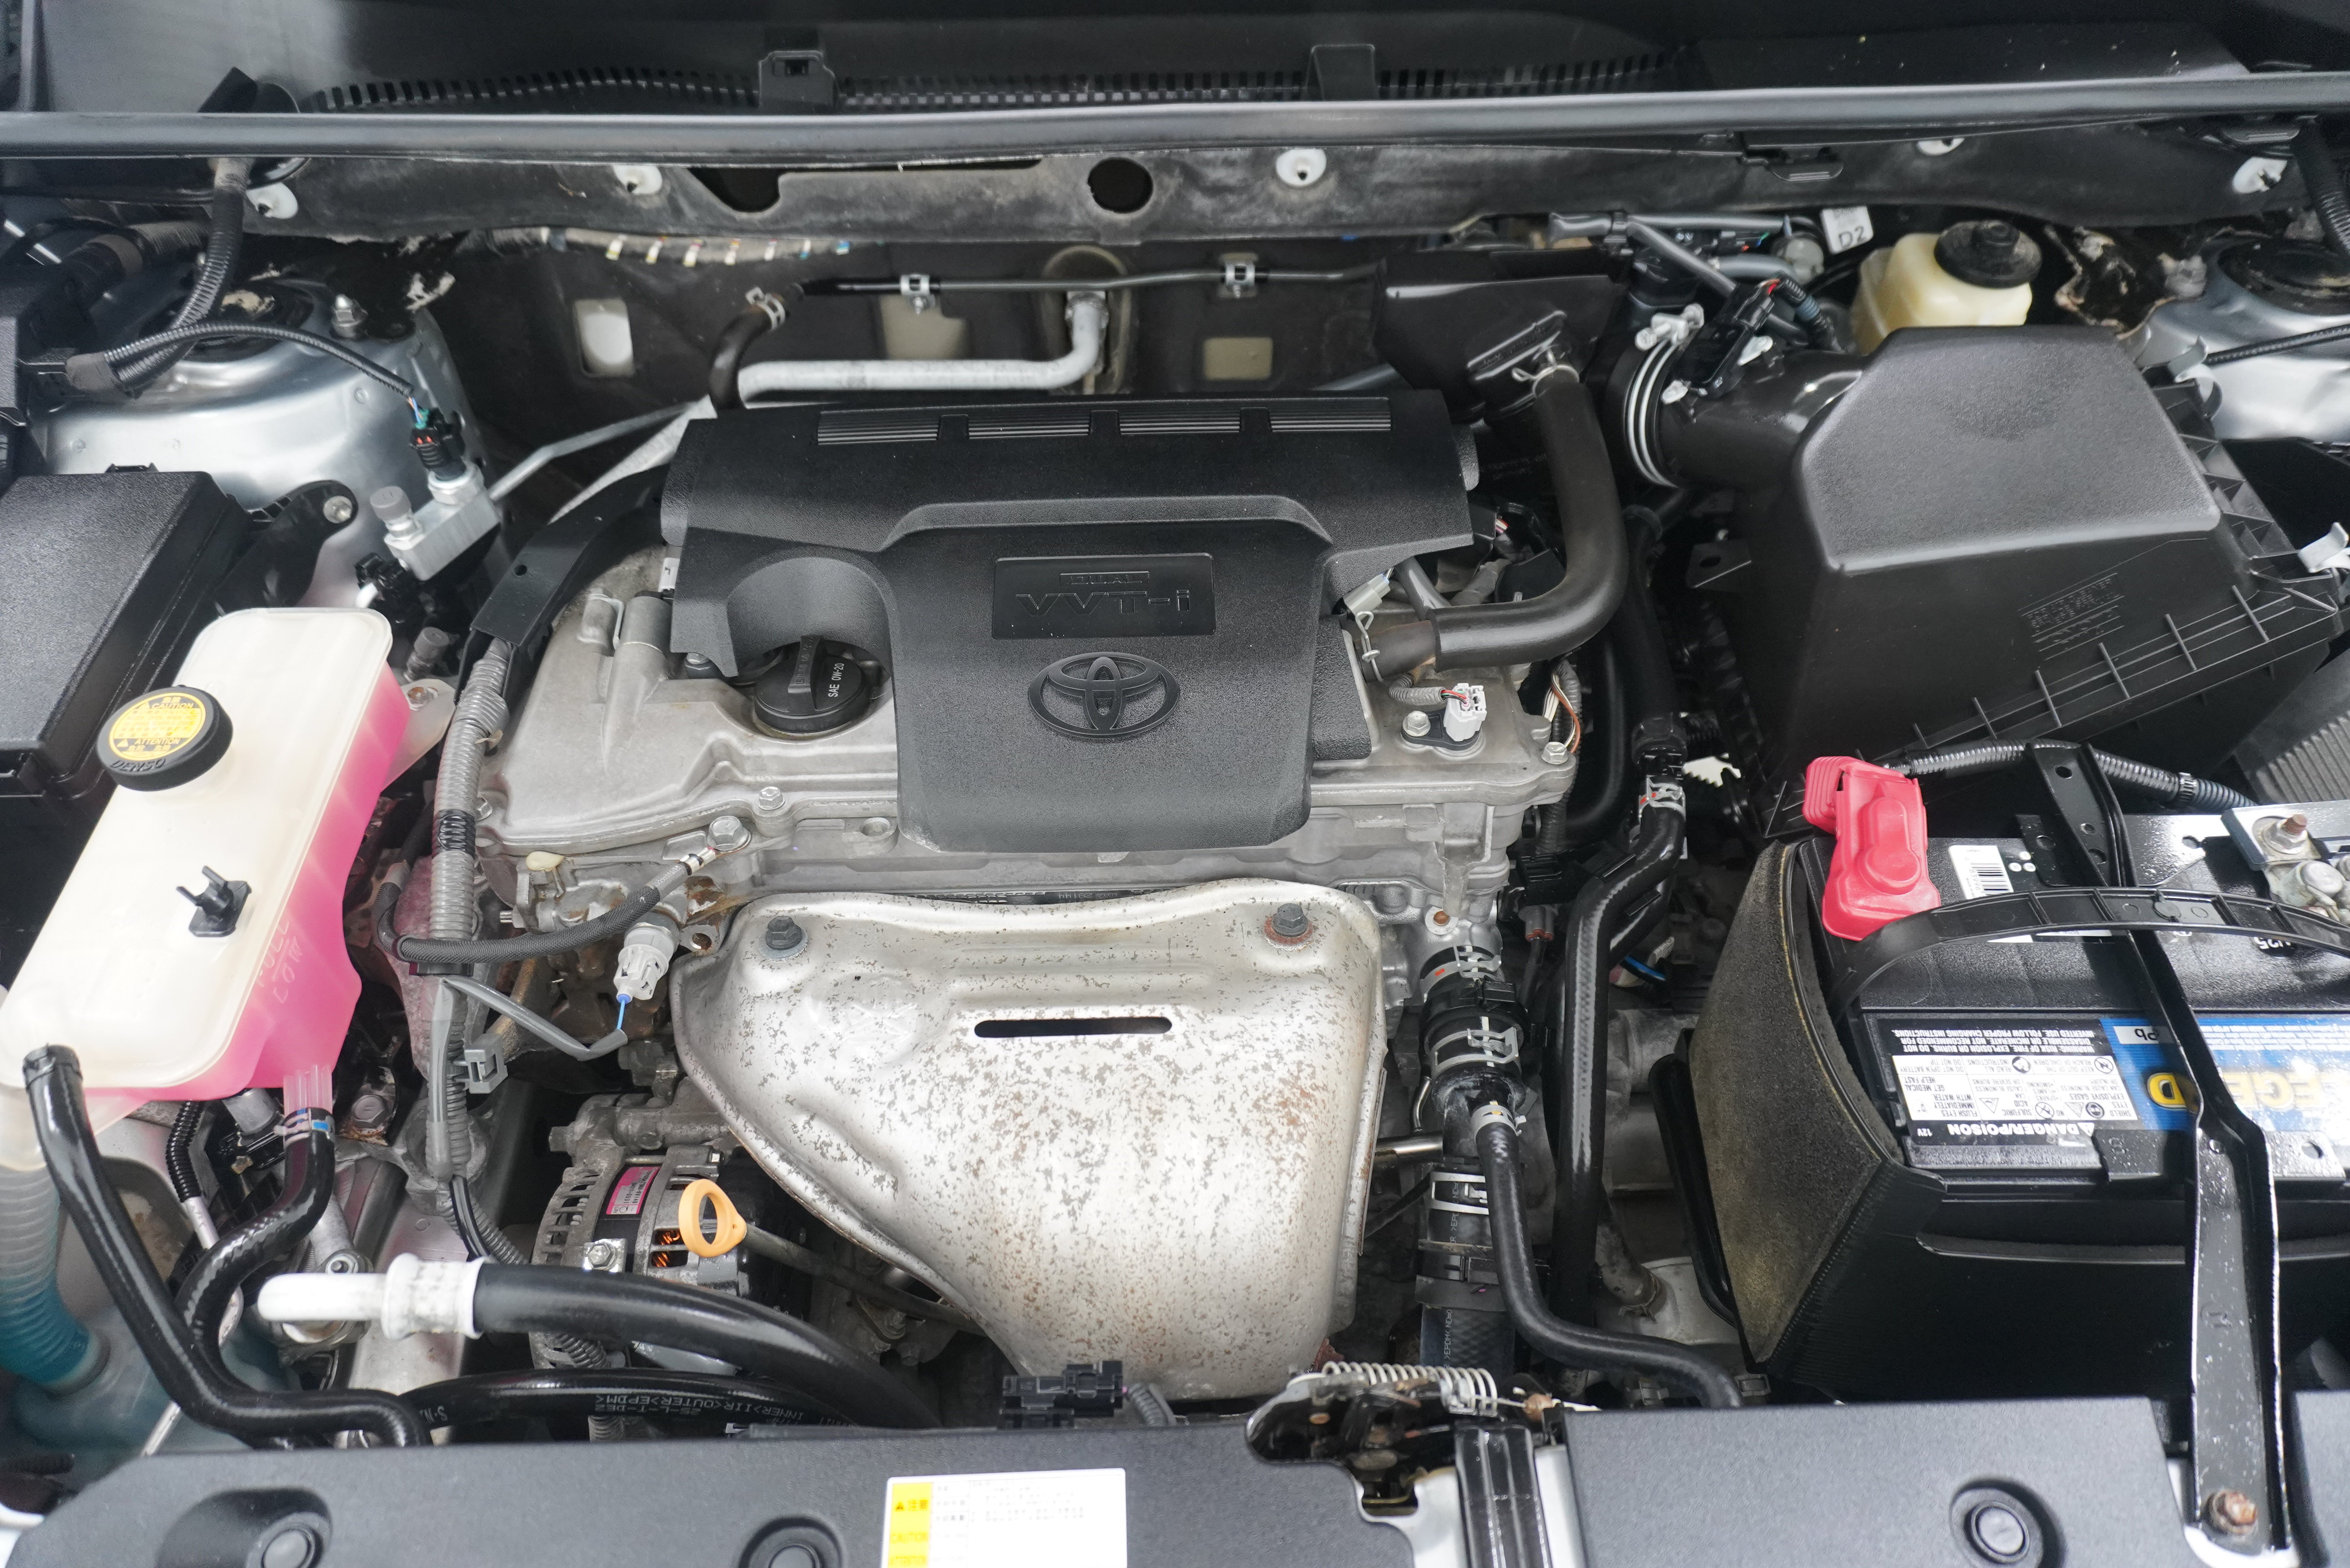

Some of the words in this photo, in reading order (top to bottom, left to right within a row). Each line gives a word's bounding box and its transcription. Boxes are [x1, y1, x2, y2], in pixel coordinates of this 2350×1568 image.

[1838, 226, 1865, 249] D2
[1015, 590, 1190, 616] VVT-i
[831, 663, 844, 681] 0W-20
[828, 684, 840, 697] SAE
[110, 758, 166, 772] DENSO
[273, 935, 303, 1004] LOW
[2134, 1027, 2158, 1041] Pb
[1917, 1128, 1933, 1136] 12V
[1947, 1124, 2079, 1135] DANGER/POISON
[890, 1532, 929, 1543] CAUTION
